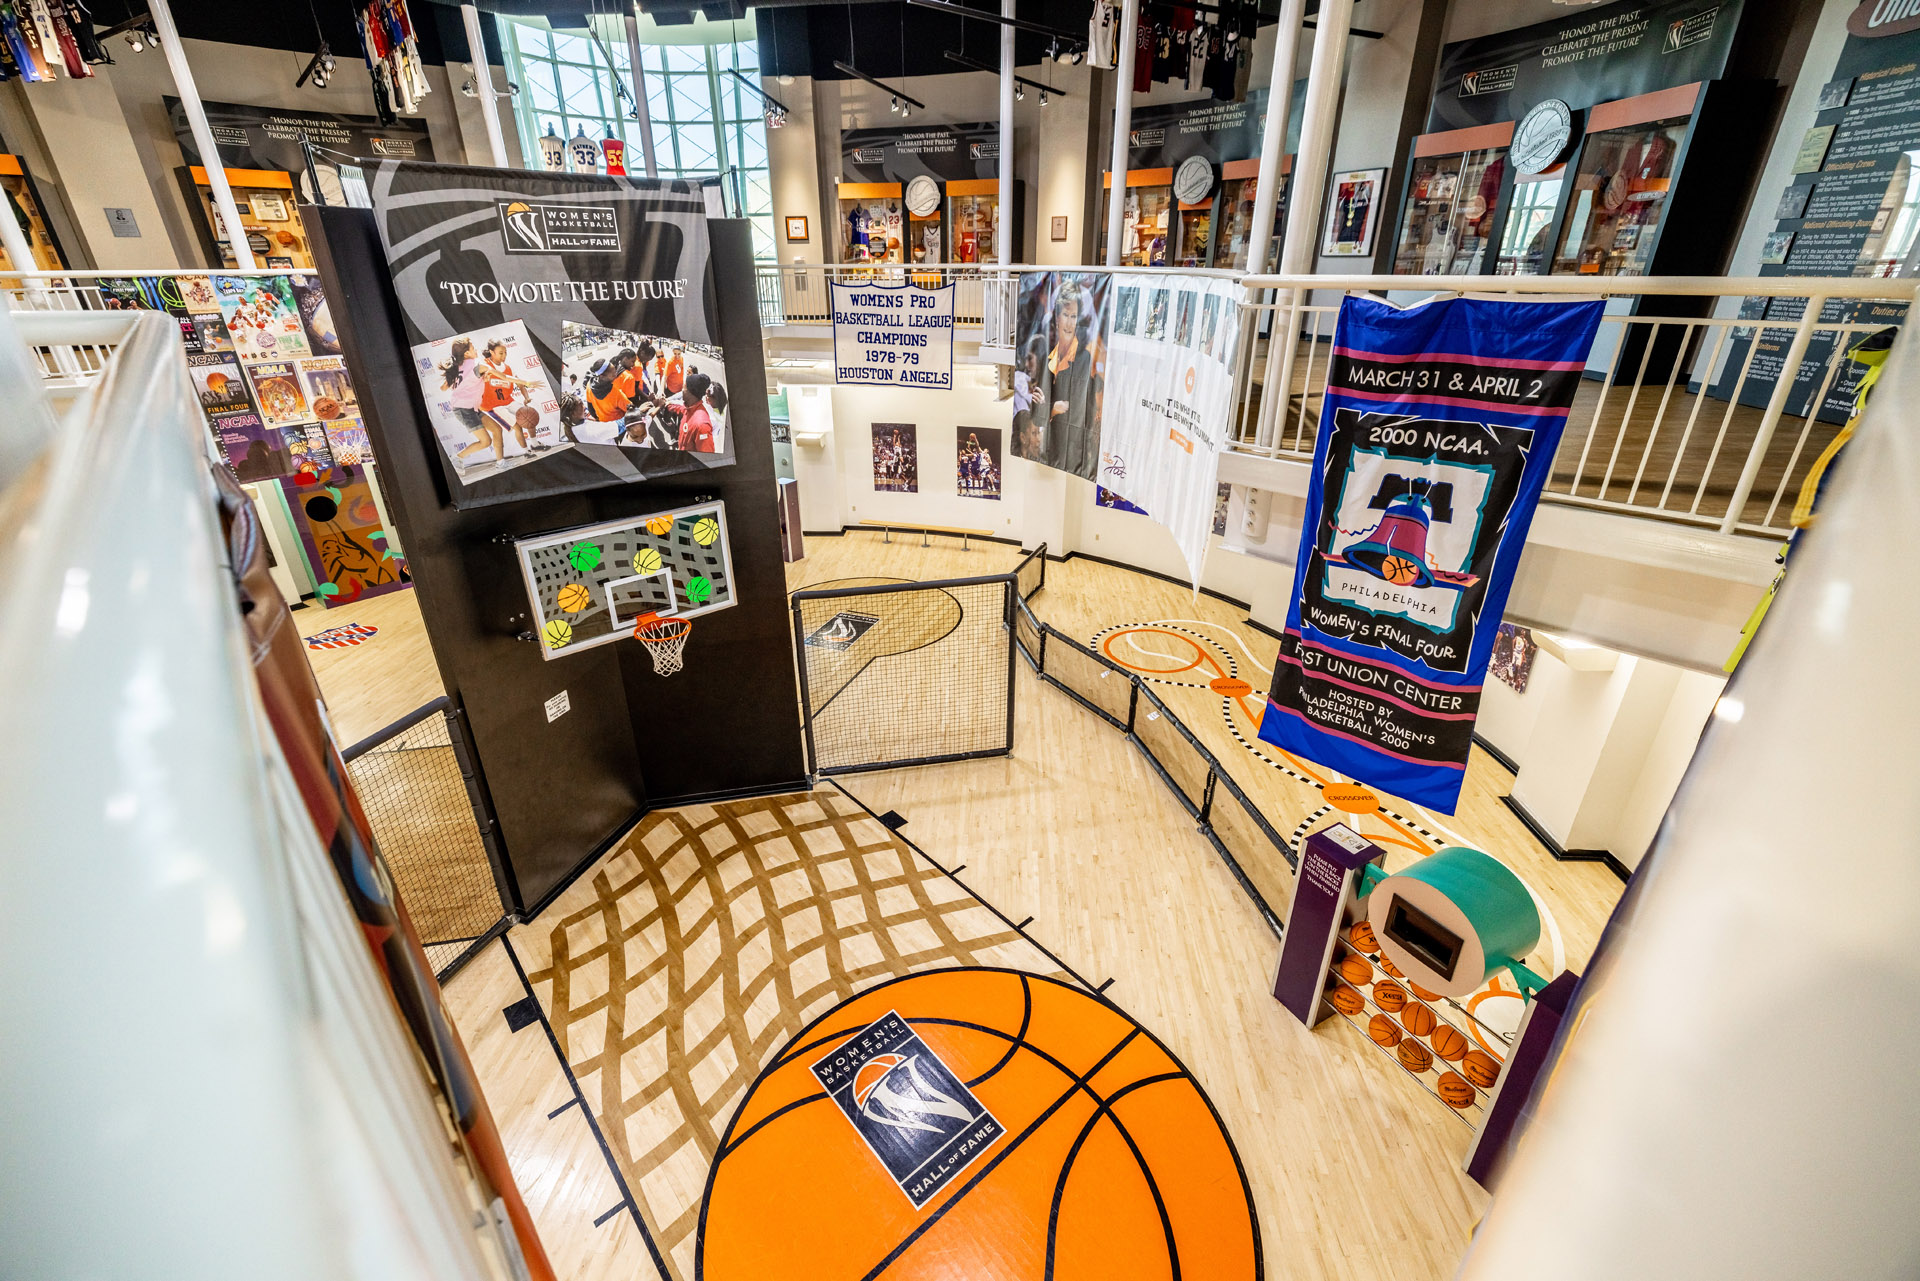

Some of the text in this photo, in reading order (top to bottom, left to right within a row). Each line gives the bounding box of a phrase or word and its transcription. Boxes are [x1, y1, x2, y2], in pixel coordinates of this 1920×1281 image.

[1559, 10, 1640, 40] "HONOR THE PAST,
[1542, 21, 1649, 56] CELEBRATE THE PRESENT,
[1542, 34, 1643, 68] PROMOTE THE FUTURE"
[1498, 80, 1513, 89] FAME
[1179, 111, 1246, 126] CELEBRATE THE PRESENT,
[1188, 108, 1212, 117] "HONOR
[270, 116, 302, 126] "HONOR
[321, 121, 339, 129] PAST,
[1180, 124, 1207, 134] PROMOTE
[267, 132, 300, 141] PROMOT
[323, 136, 351, 144] FUTURE"
[320, 128, 352, 137] PRESENT,
[545, 151, 562, 166] 33
[576, 150, 595, 166] 33
[606, 149, 623, 167] 53
[1856, 160, 1876, 168] Crews
[547, 211, 613, 221] WOMEN'S
[548, 220, 614, 228] BASKETBALL
[889, 216, 899, 224] 23
[590, 238, 616, 246] FAME
[440, 279, 687, 305] "PROMOTE THE FUTURE"
[850, 294, 935, 308] WOMENS PRO
[1871, 307, 1896, 316] Duties
[835, 312, 951, 328] BASKETBALL LEAGUE
[857, 331, 927, 347] CHAMPIONS
[187, 354, 222, 366] NCAA
[301, 358, 340, 371] NCAA
[866, 350, 919, 365] 1978-79
[839, 367, 949, 385] HOUSTON ANGELS
[1348, 366, 1543, 398] MARCH 31 & APRIL 2
[495, 389, 504, 400] 16
[218, 415, 259, 429] NCAA
[1369, 427, 1489, 455] 2000 NCAA.
[1104, 455, 1127, 479] Pat
[1341, 582, 1437, 615] PHILADELPHIA
[1310, 607, 1456, 659] WOMEN'S FINAL FOUR.
[1295, 642, 1462, 710] FRST UNION CENTER
[1329, 689, 1393, 718] HOSTED BY
[1307, 706, 1410, 750] BASKETBALL 2000
[1374, 716, 1436, 744] WOMEN'S
[1307, 855, 1341, 882] THE BALLS BACK
[1314, 854, 1338, 873] PLEASE PUT
[1304, 864, 1340, 892] WHEN FINISHED
[1307, 874, 1323, 889] THANK
[820, 1020, 899, 1077] WOMEN'S
[826, 1028, 904, 1084] BASKETBALL
[911, 1122, 994, 1198] HALL OF FAME
